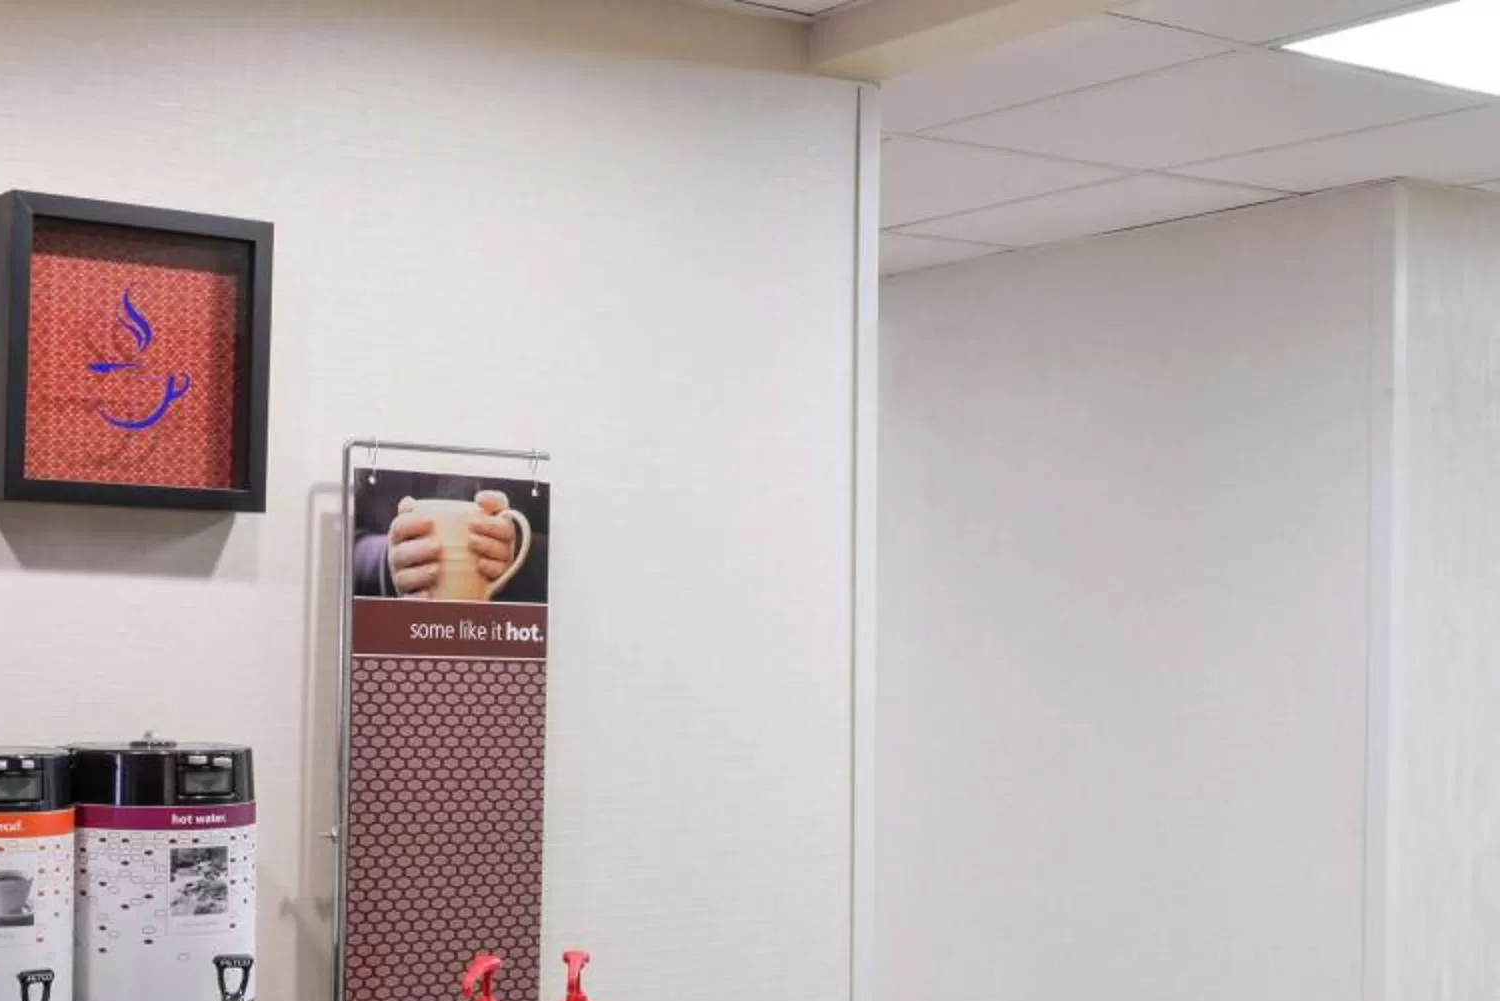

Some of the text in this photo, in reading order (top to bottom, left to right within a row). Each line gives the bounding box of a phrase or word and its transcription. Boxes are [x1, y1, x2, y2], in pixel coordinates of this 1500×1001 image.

[409, 619, 544, 642] some like it hot.
[171, 813, 193, 825] hot
